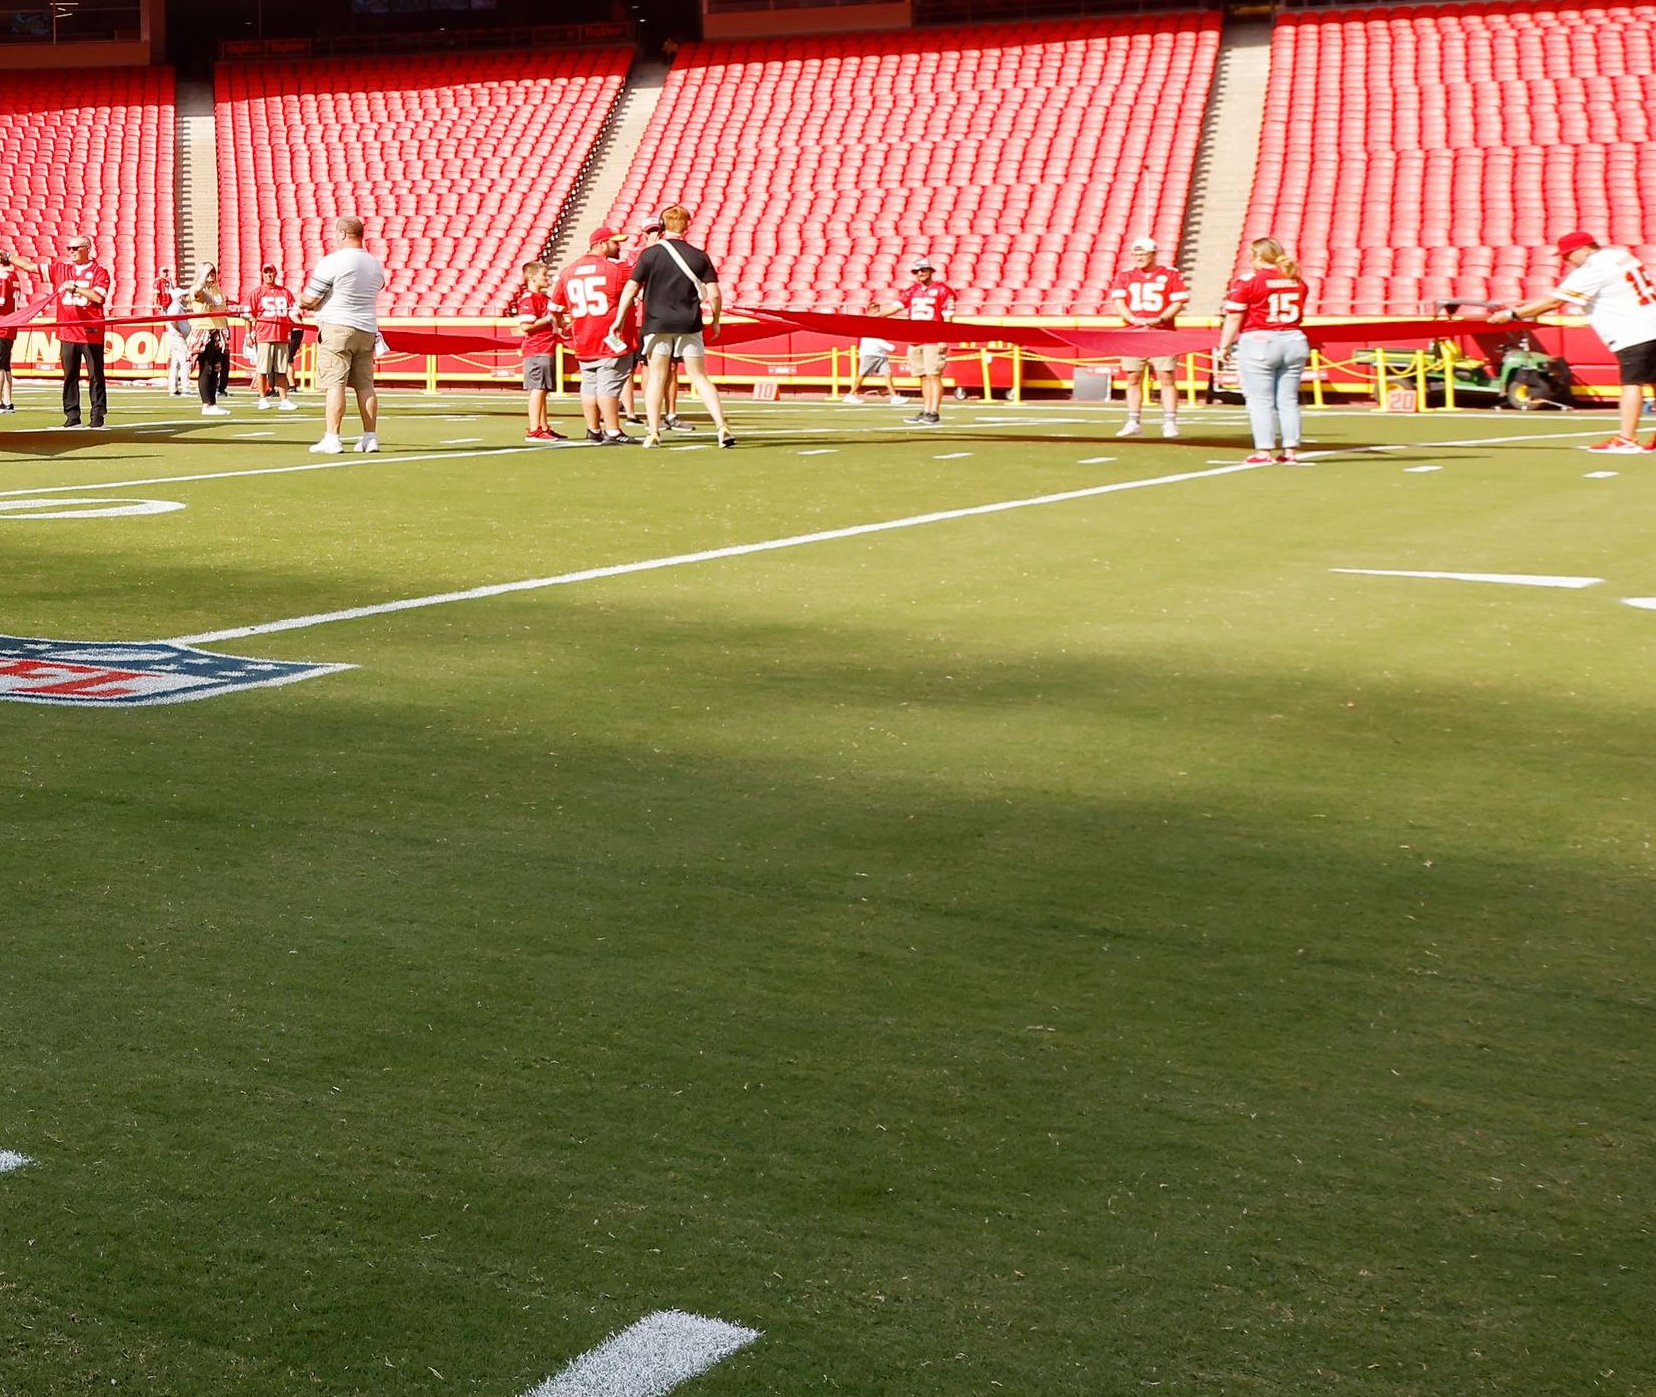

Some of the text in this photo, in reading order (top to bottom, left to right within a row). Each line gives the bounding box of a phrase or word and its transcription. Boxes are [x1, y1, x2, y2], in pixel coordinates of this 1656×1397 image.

[566, 276, 609, 318] 95
[1129, 283, 1165, 311] 15
[1266, 293, 1301, 323] 15
[758, 383, 774, 399] 10
[1390, 392, 1415, 410] 20
